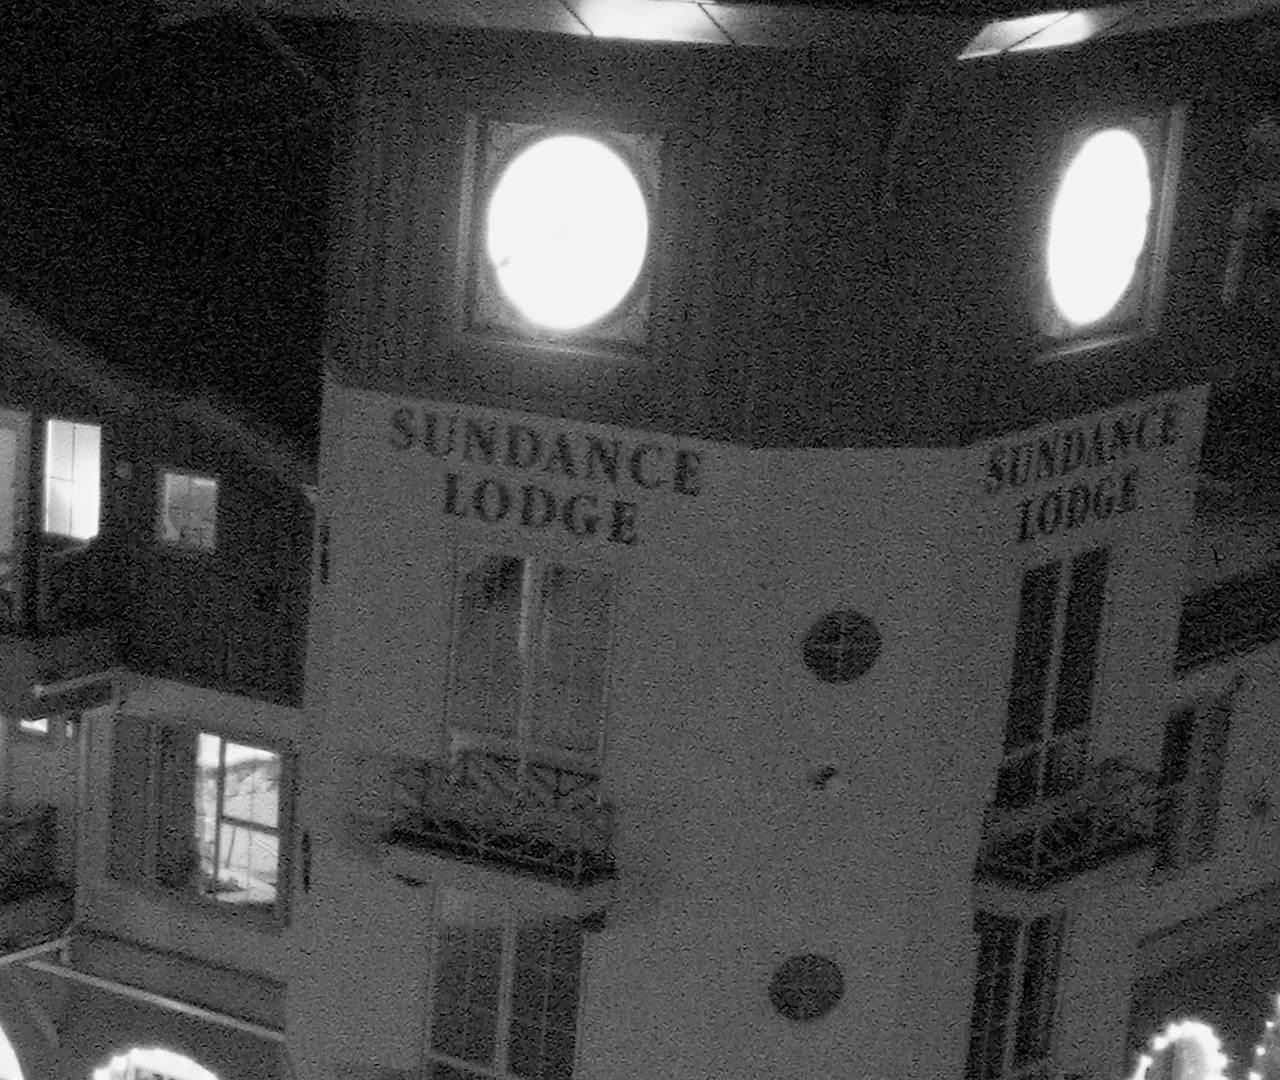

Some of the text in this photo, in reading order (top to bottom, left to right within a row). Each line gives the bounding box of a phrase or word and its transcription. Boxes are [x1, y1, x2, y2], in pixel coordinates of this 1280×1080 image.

[388, 405, 703, 498] SUNDANCE
[985, 400, 1182, 493] SUNDANCE
[443, 471, 639, 546] LODGE
[1017, 464, 1141, 544] LODGE
